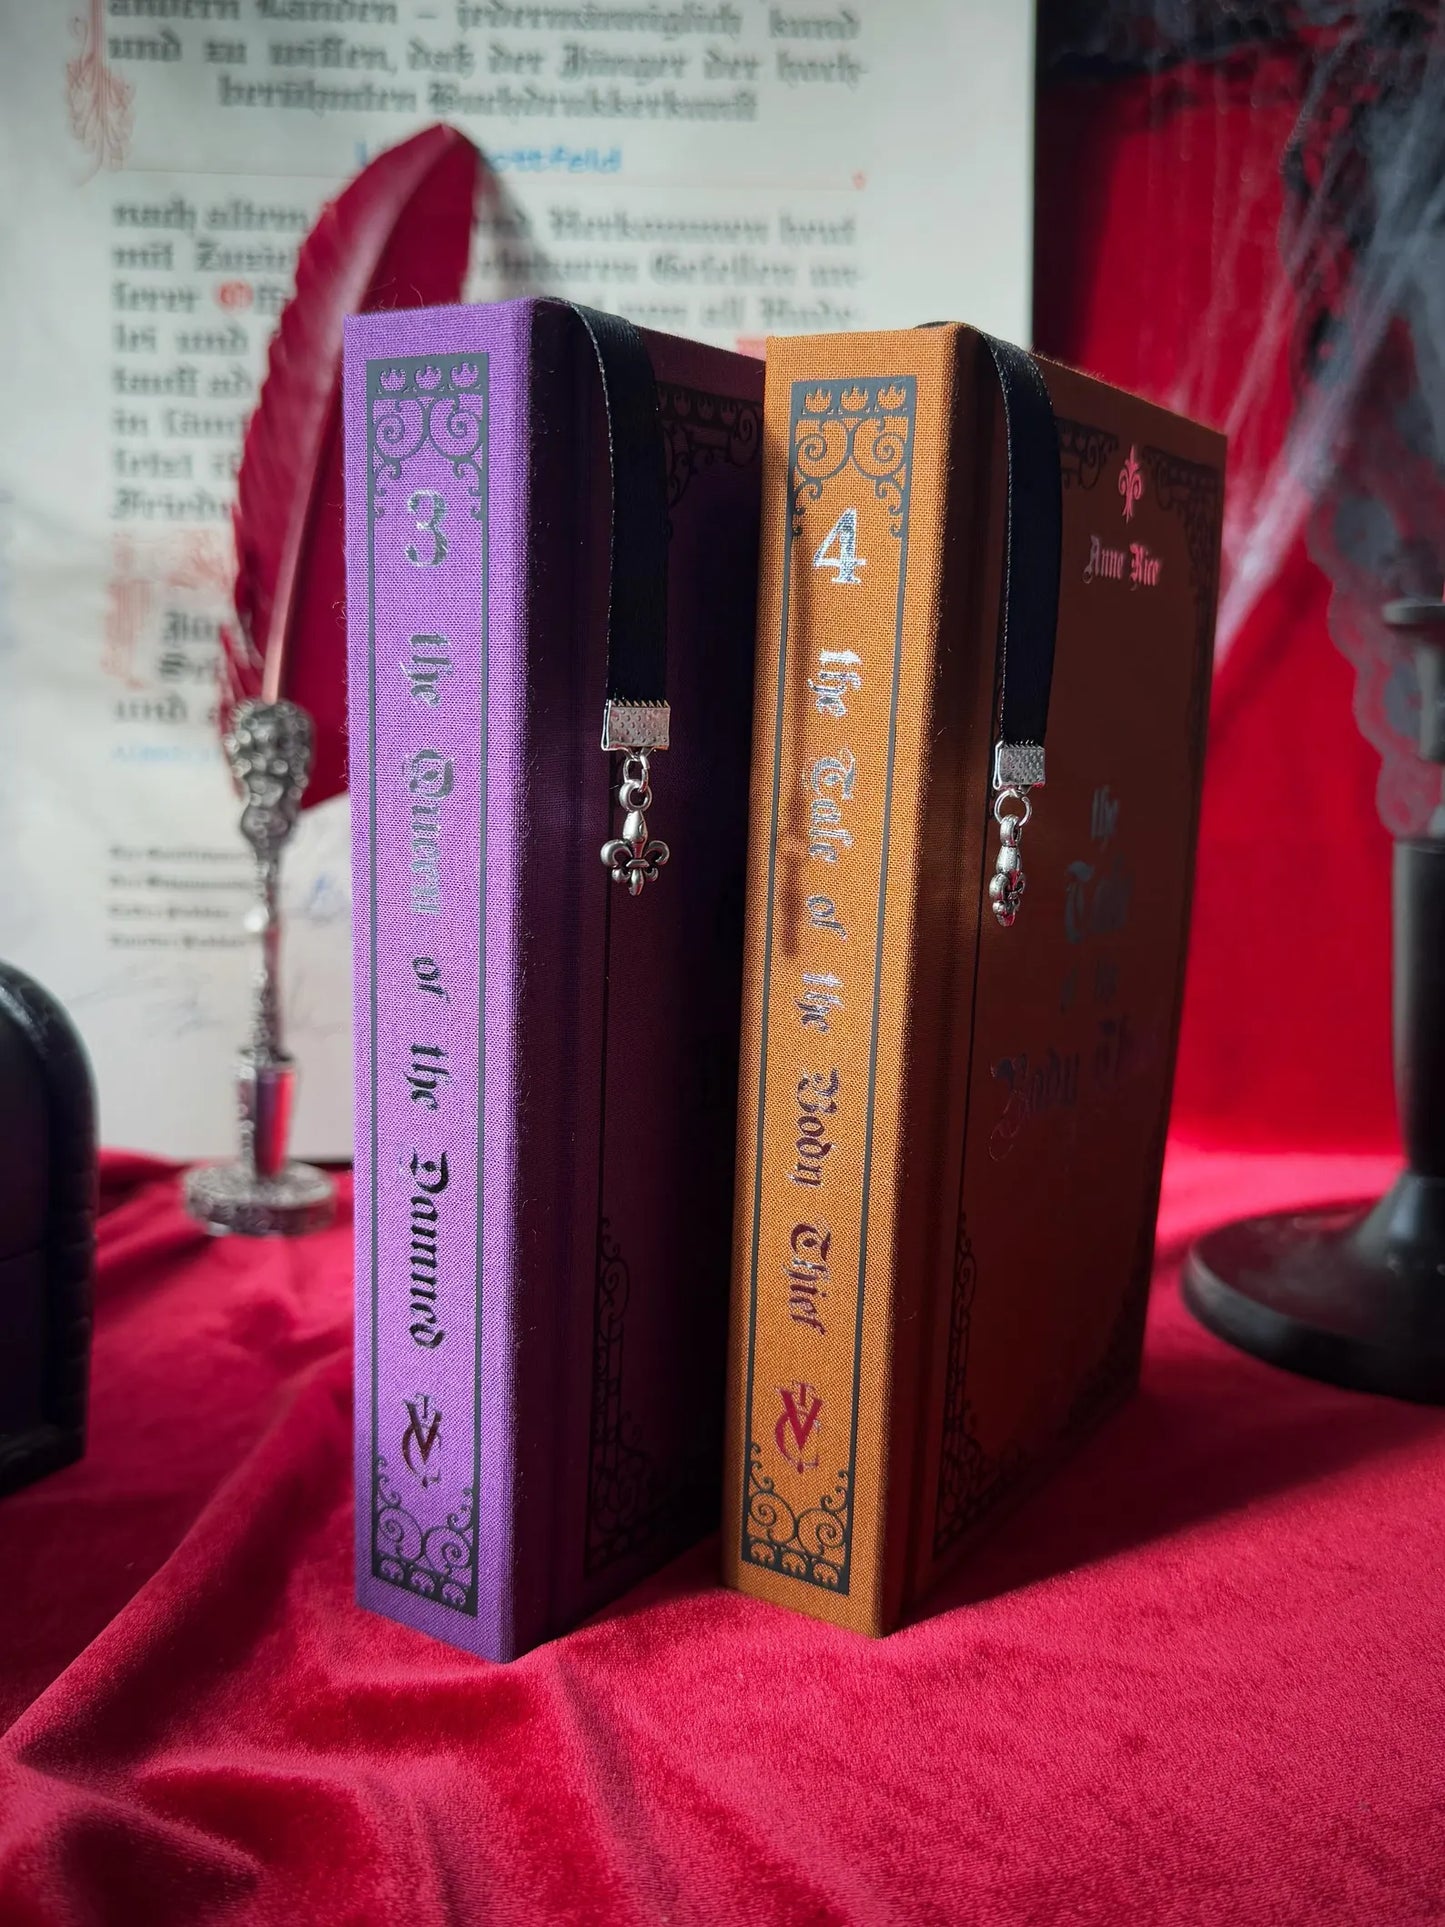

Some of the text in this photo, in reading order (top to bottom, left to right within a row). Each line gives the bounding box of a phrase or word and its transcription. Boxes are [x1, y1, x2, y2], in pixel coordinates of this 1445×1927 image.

[404, 488, 450, 568] 3
[811, 507, 867, 584] 4
[1081, 535, 1162, 591] Anne Rice
[400, 631, 455, 1350] the Queen of the Damned
[781, 647, 863, 1336] the Tale of the Body Thief
